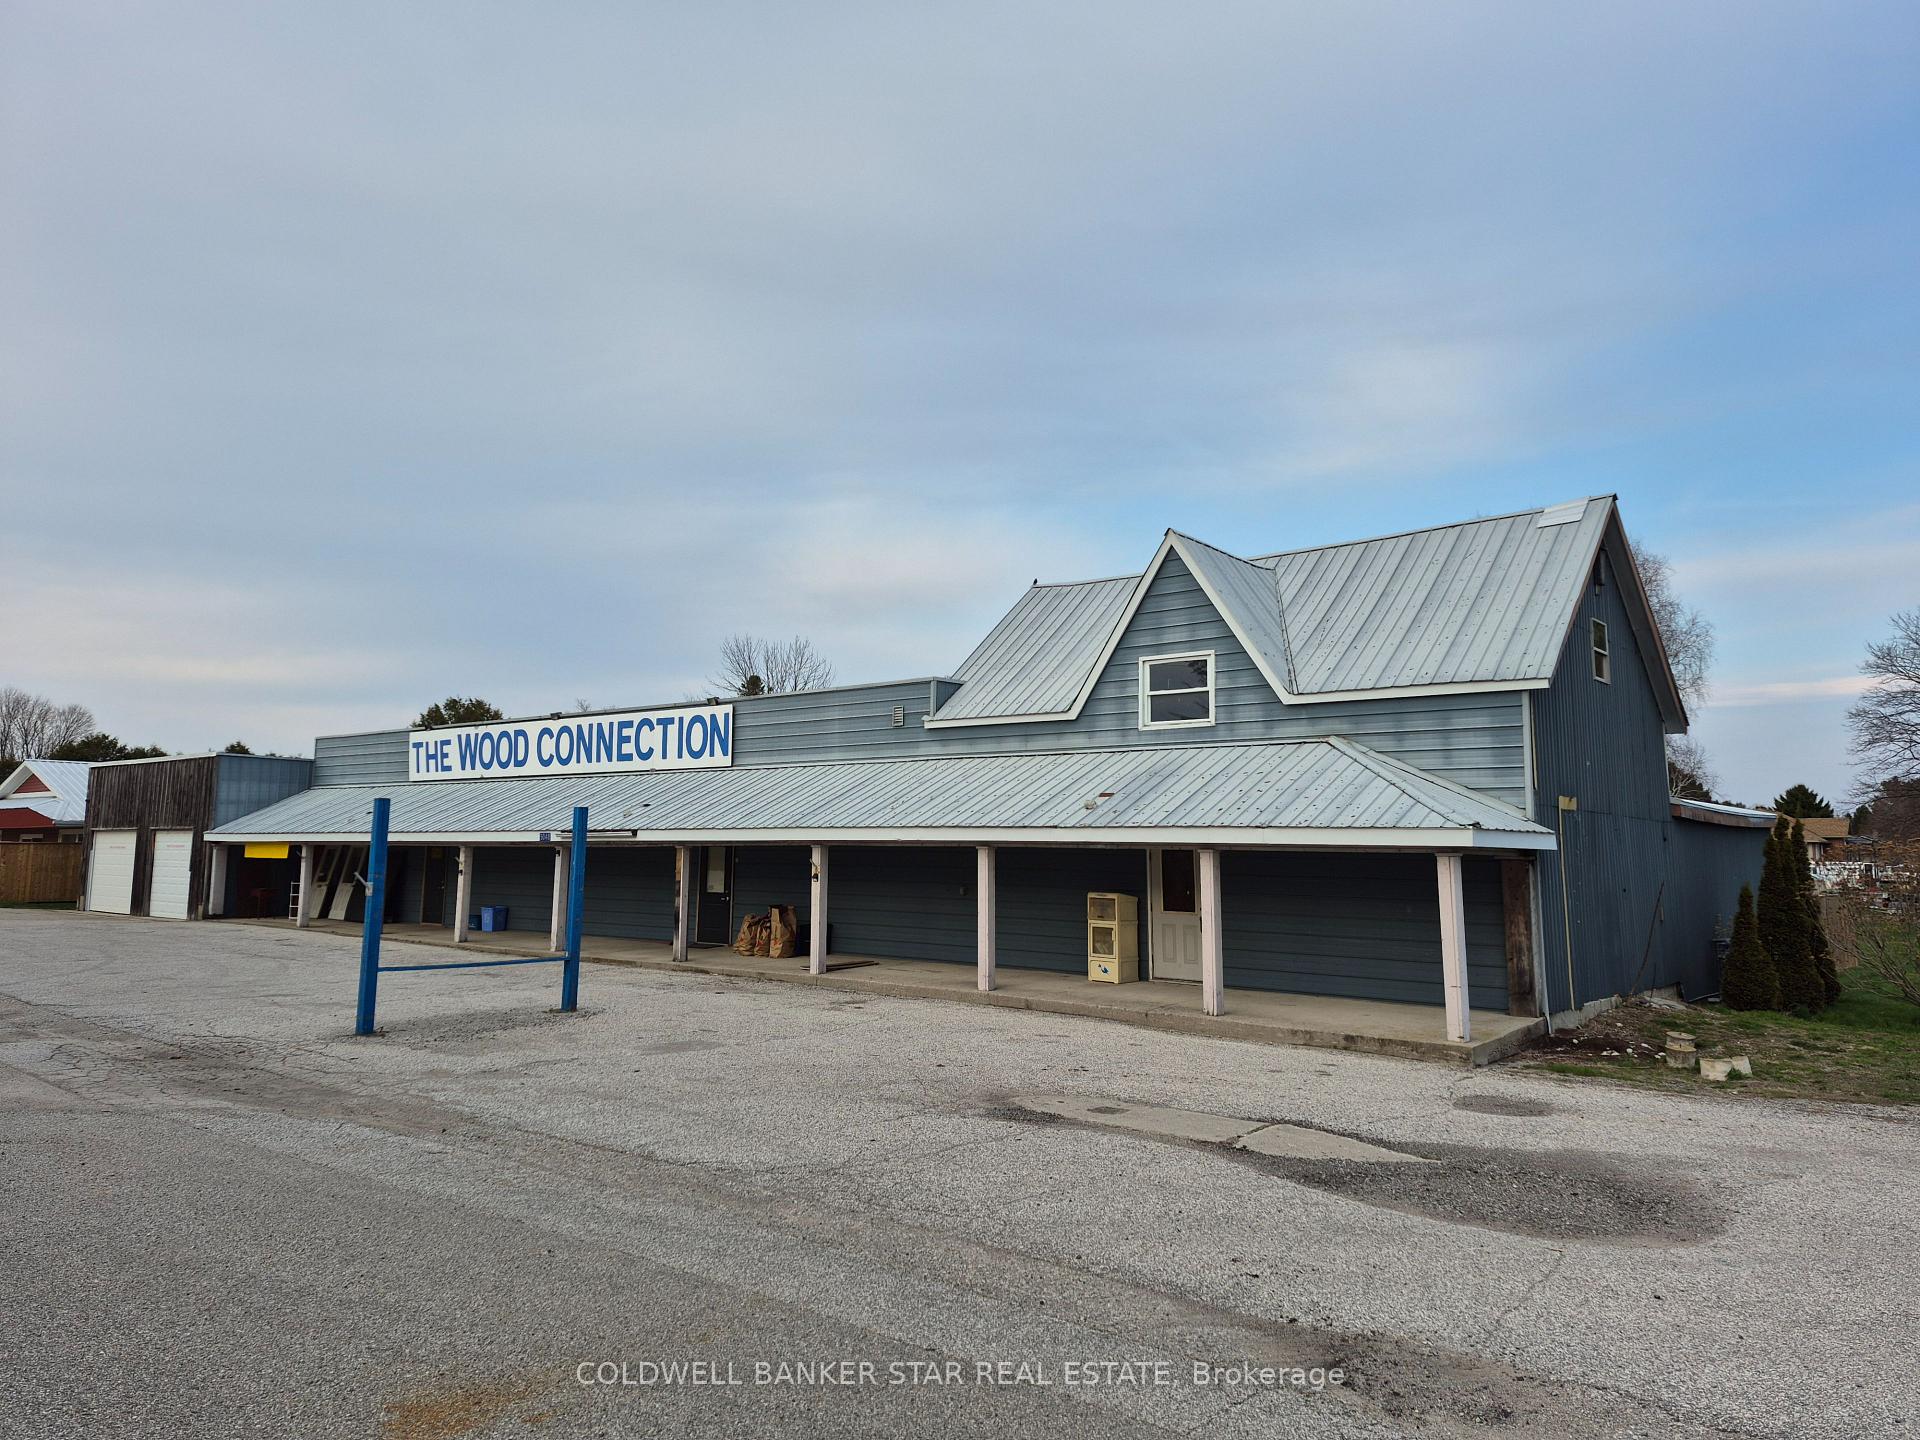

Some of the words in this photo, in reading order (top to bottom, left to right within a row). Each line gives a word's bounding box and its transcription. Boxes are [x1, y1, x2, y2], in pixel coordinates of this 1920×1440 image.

[411, 740, 452, 774] THE
[457, 728, 529, 771] WOOD
[536, 712, 730, 768] CONNECTION
